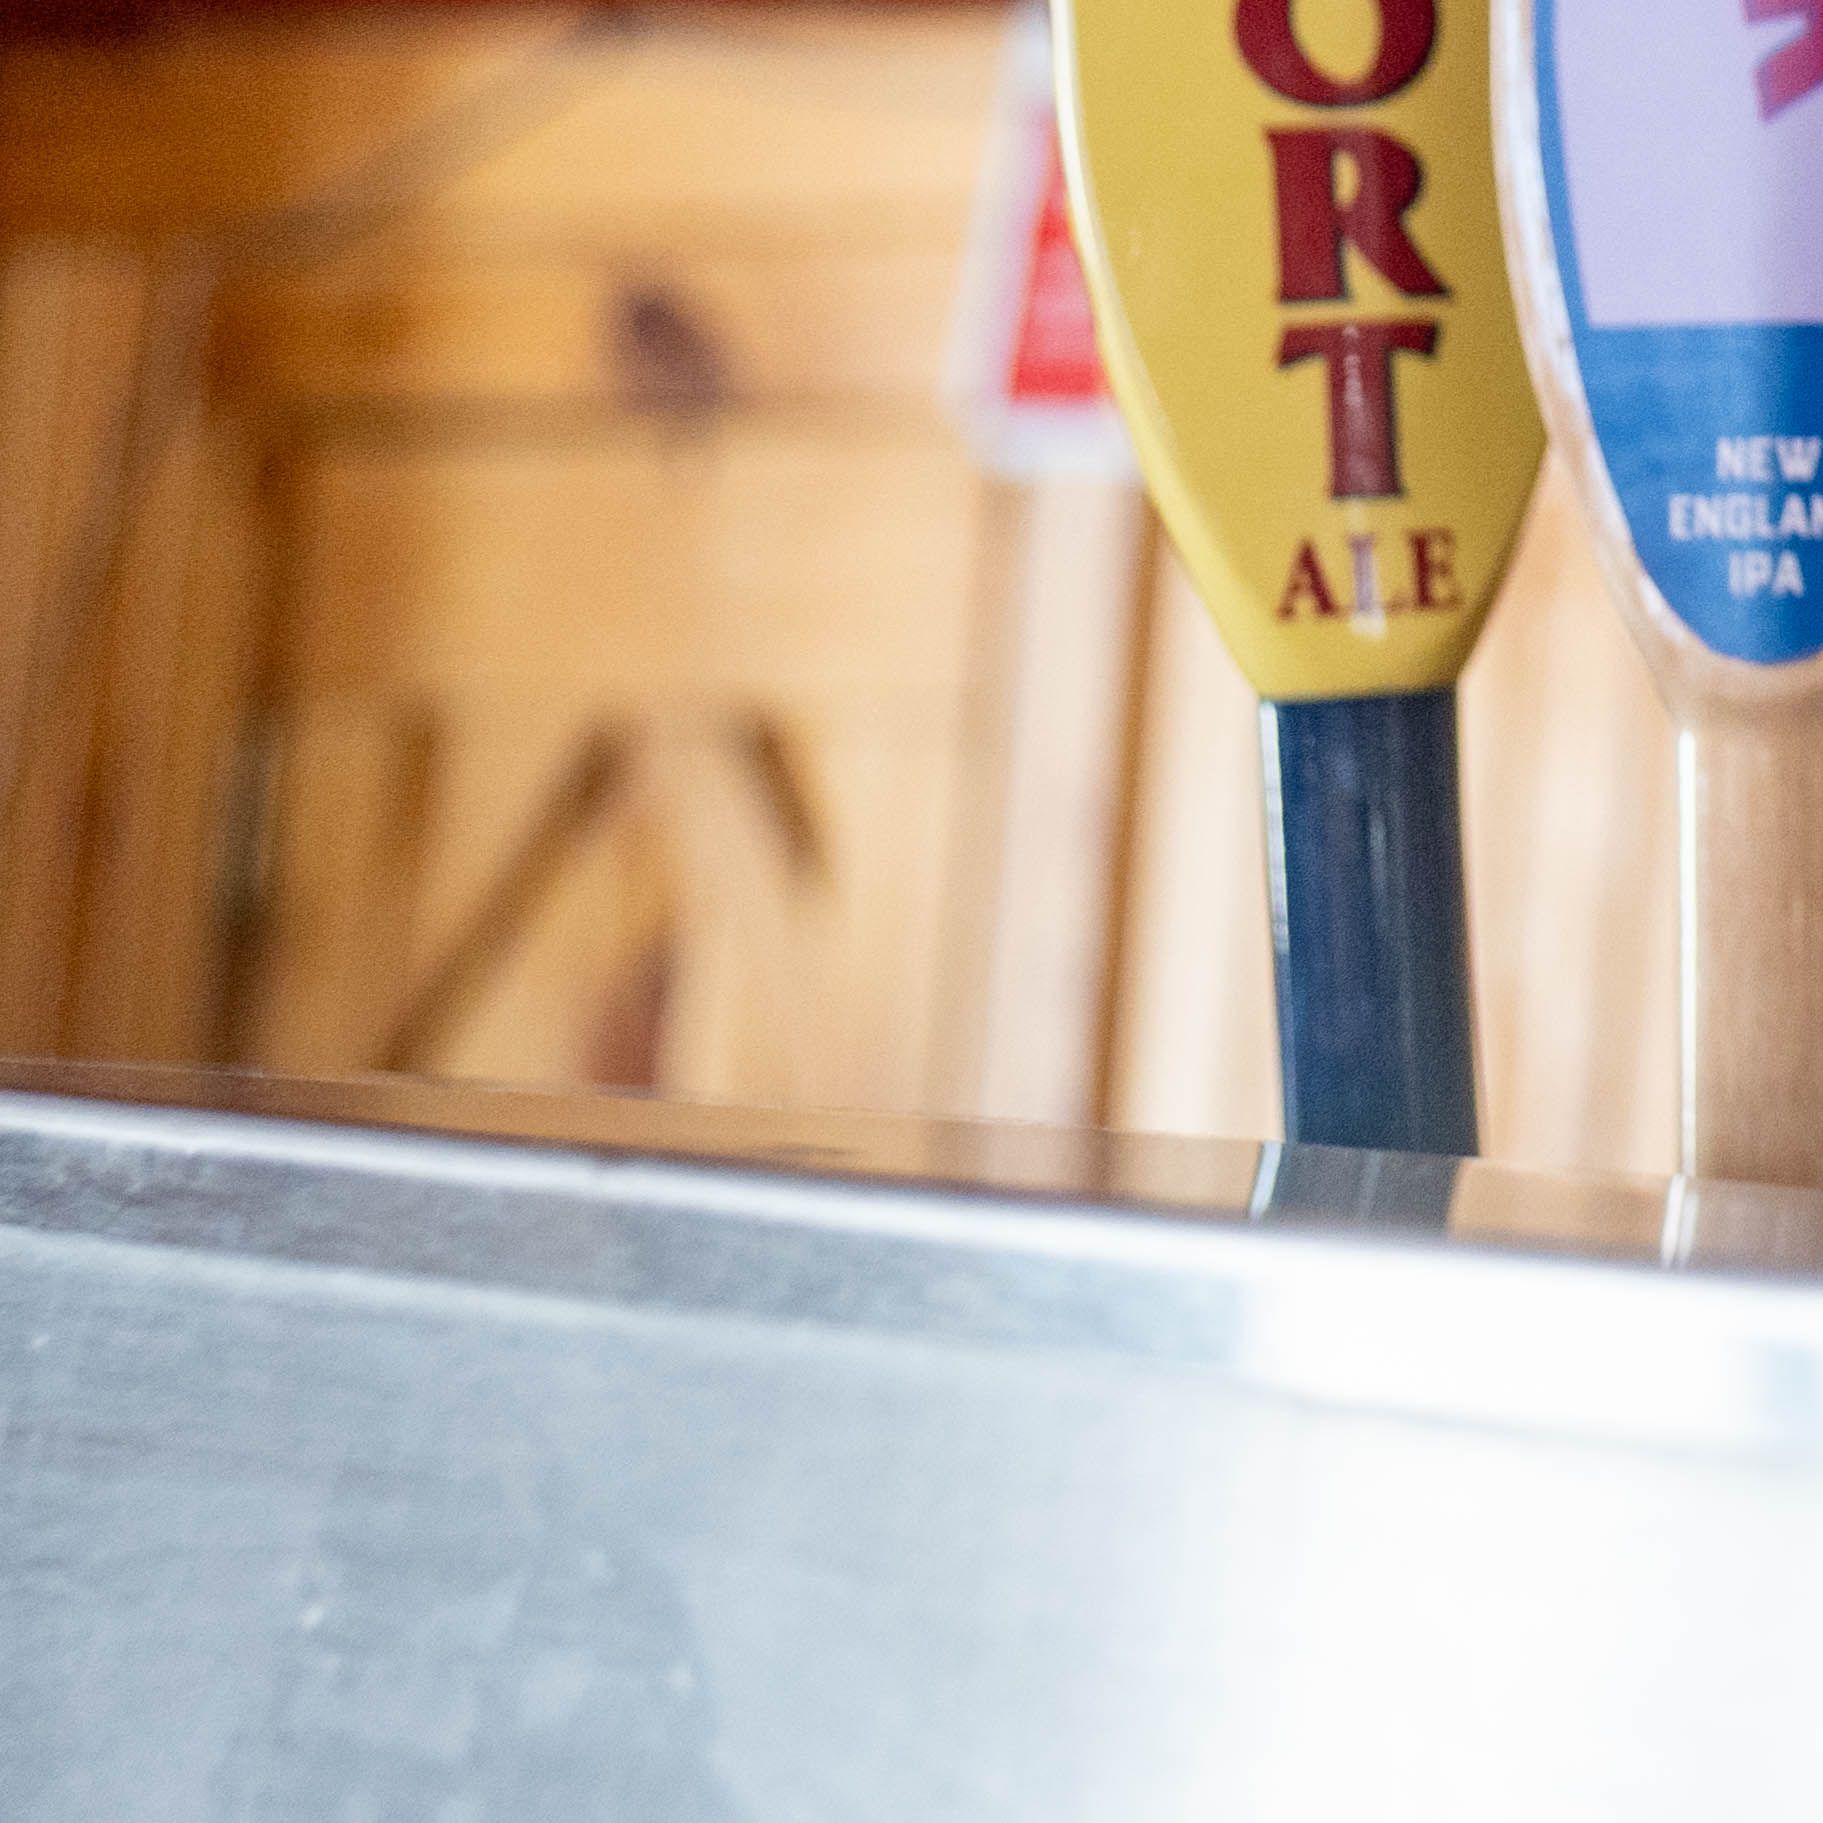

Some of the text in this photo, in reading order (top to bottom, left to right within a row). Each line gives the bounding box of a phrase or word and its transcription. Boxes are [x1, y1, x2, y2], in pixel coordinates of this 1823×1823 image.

[1715, 436, 1821, 481] NEW
[1276, 528, 1465, 624] ALE
[1728, 549, 1804, 597] IPA
